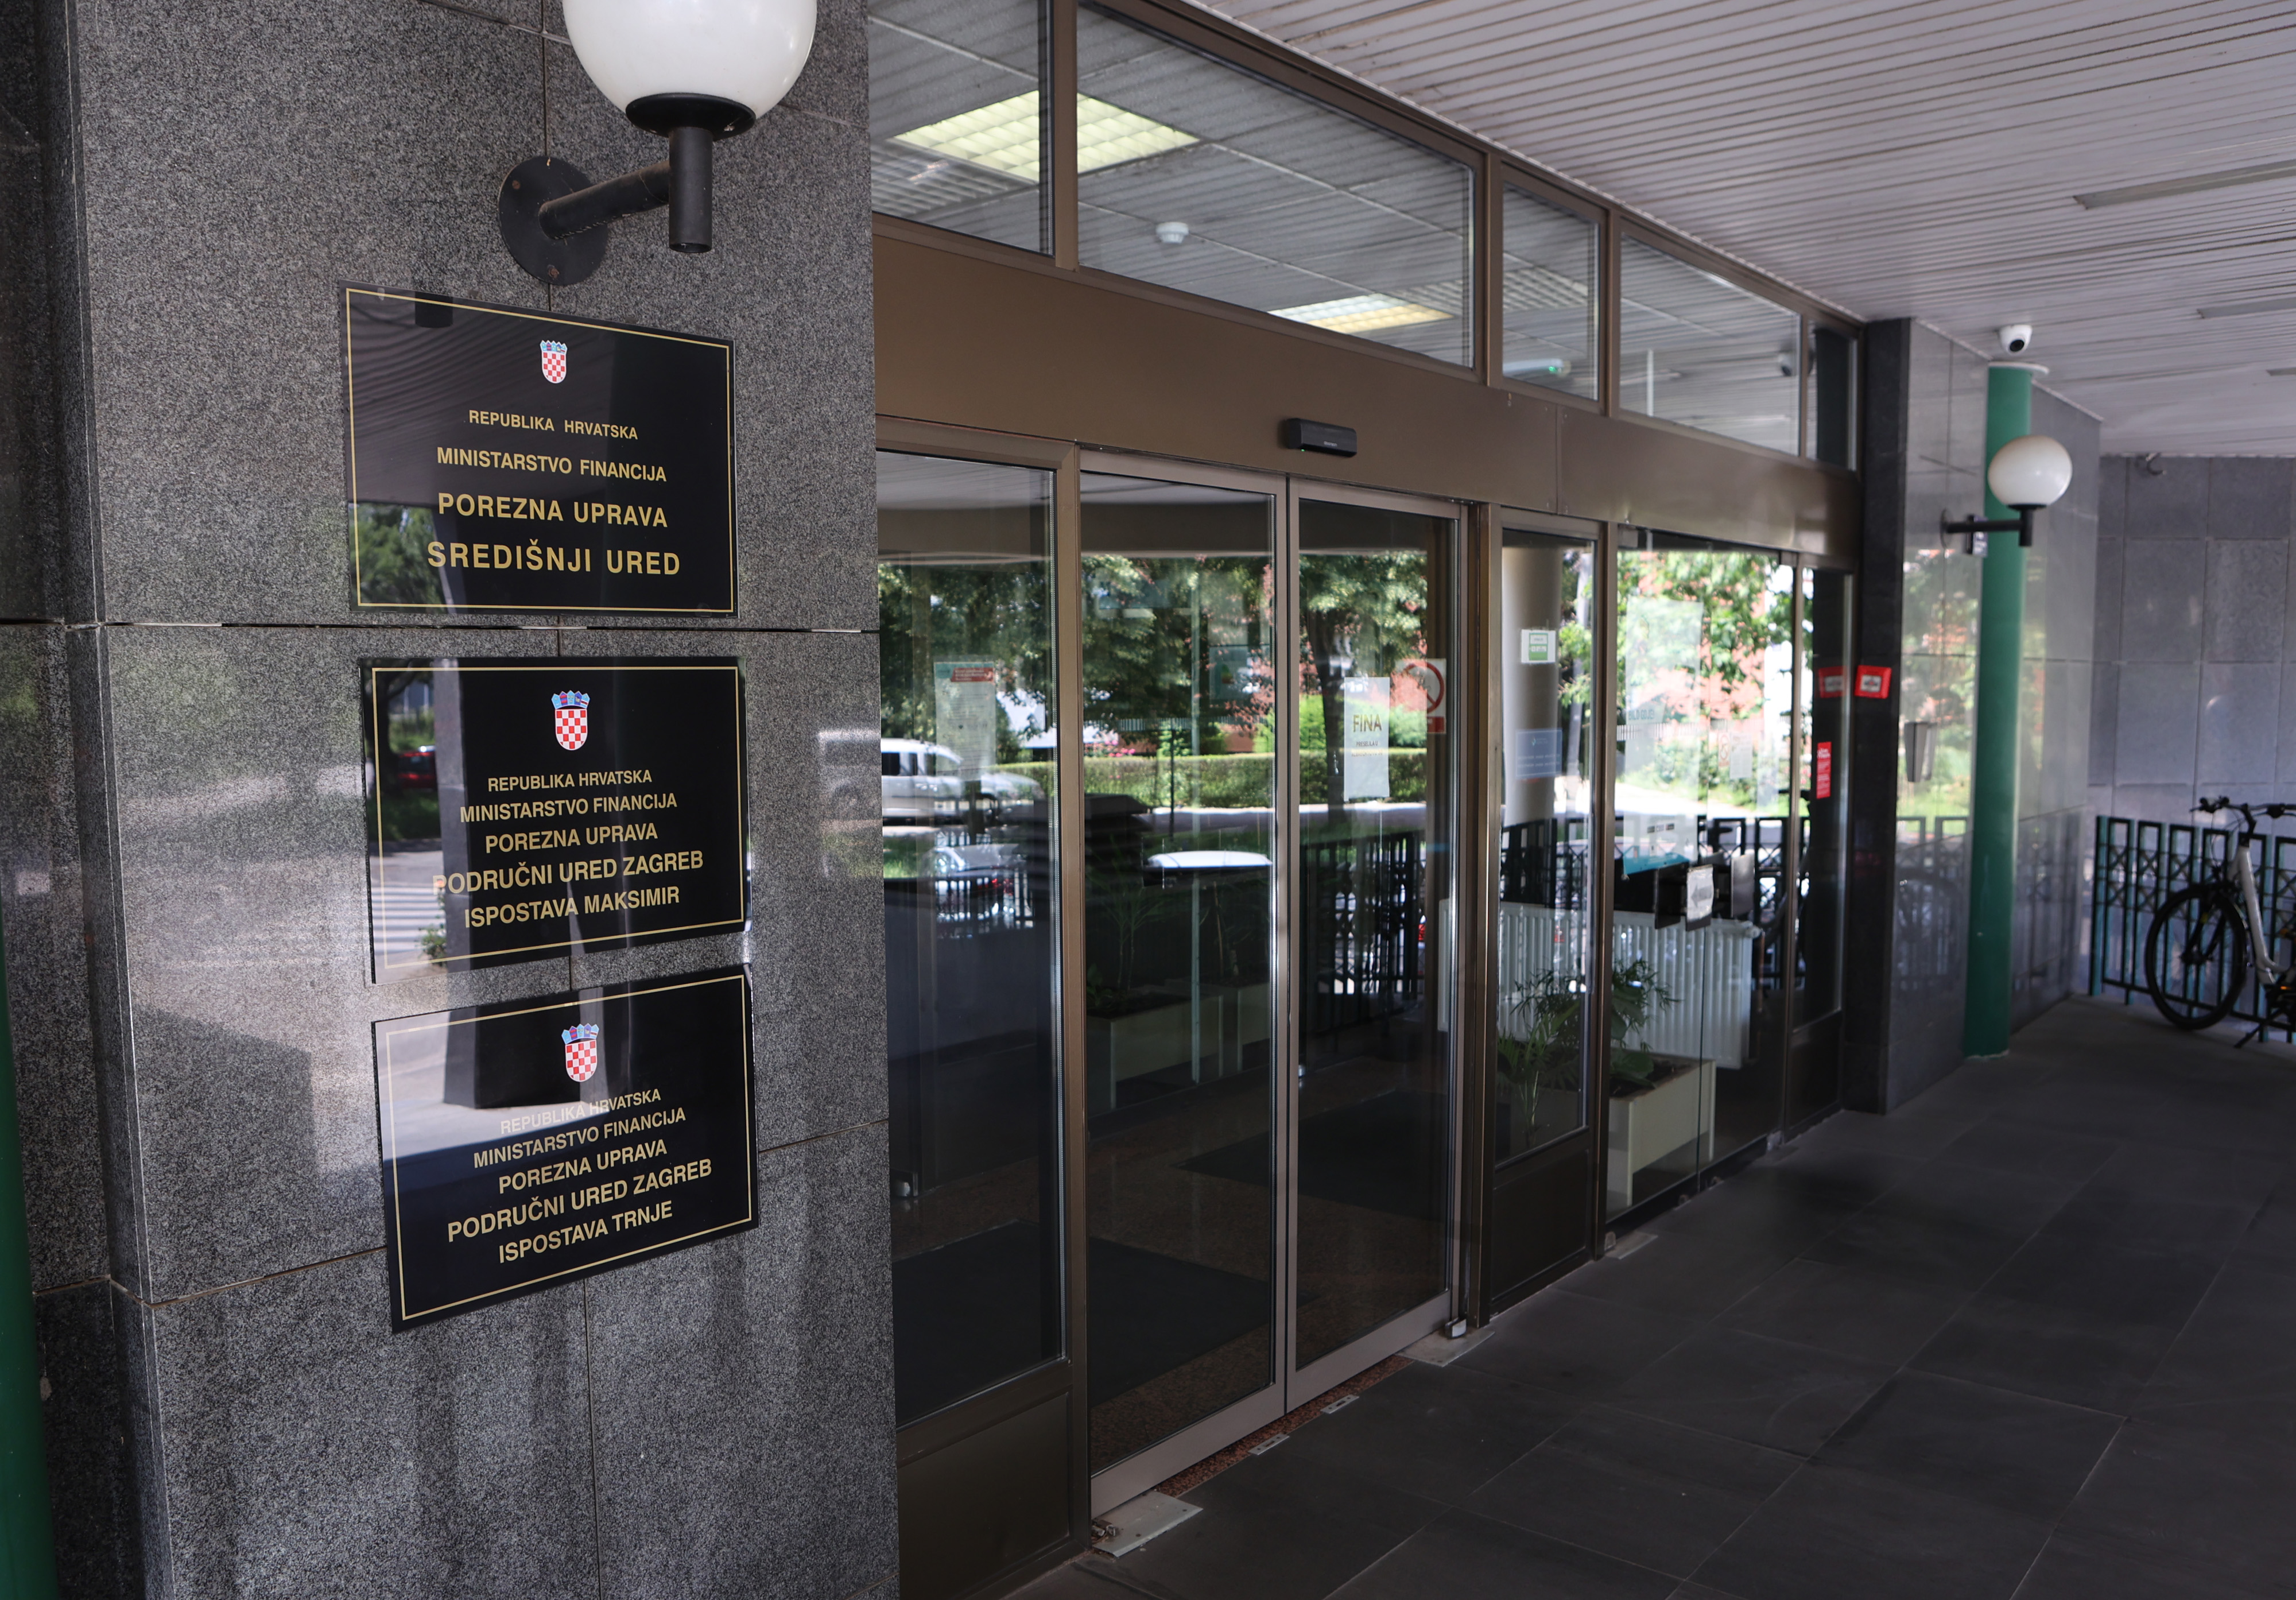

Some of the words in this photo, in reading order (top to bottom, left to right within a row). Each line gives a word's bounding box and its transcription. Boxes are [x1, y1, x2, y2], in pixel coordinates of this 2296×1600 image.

[470, 410, 554, 431] REPUBLIKA
[565, 420, 638, 440] HRVATSKA
[437, 447, 572, 474] MINISTARSTVO
[580, 460, 666, 481] FINANCIJA
[439, 493, 563, 521] POREZNA
[574, 502, 668, 527] UPRAVA
[428, 539, 591, 572] SREDIŠNJI
[607, 550, 680, 575] URED
[1353, 714, 1382, 732] FINA
[488, 773, 575, 792] REPUBLIKA
[579, 769, 652, 787] HRVATSKA
[460, 799, 588, 822] MINISTARSTVO
[594, 793, 677, 813] FINANCIJA
[486, 829, 580, 853] POREZNA
[586, 823, 658, 844] UPRAVA
[433, 862, 552, 894] PODRUČNI
[560, 859, 617, 883] URED
[623, 851, 703, 876] ZAGREB
[465, 898, 578, 928] ISPOSTAVA
[585, 886, 679, 913] MAKSIMIR
[501, 1105, 585, 1134] REPUBLIKA
[589, 1089, 661, 1114] HRVATSKA
[474, 1127, 599, 1168] MINISTARSTVO
[604, 1107, 686, 1139] FINANCIJA
[499, 1157, 591, 1194] POREZNA
[598, 1140, 667, 1171] UPRAVA
[448, 1195, 564, 1242] PODRUČNI
[572, 1180, 627, 1211] URED
[633, 1159, 712, 1195] ZAGREB
[499, 1219, 608, 1263] ISPOSTAVA
[612, 1201, 673, 1231] TRNJE
